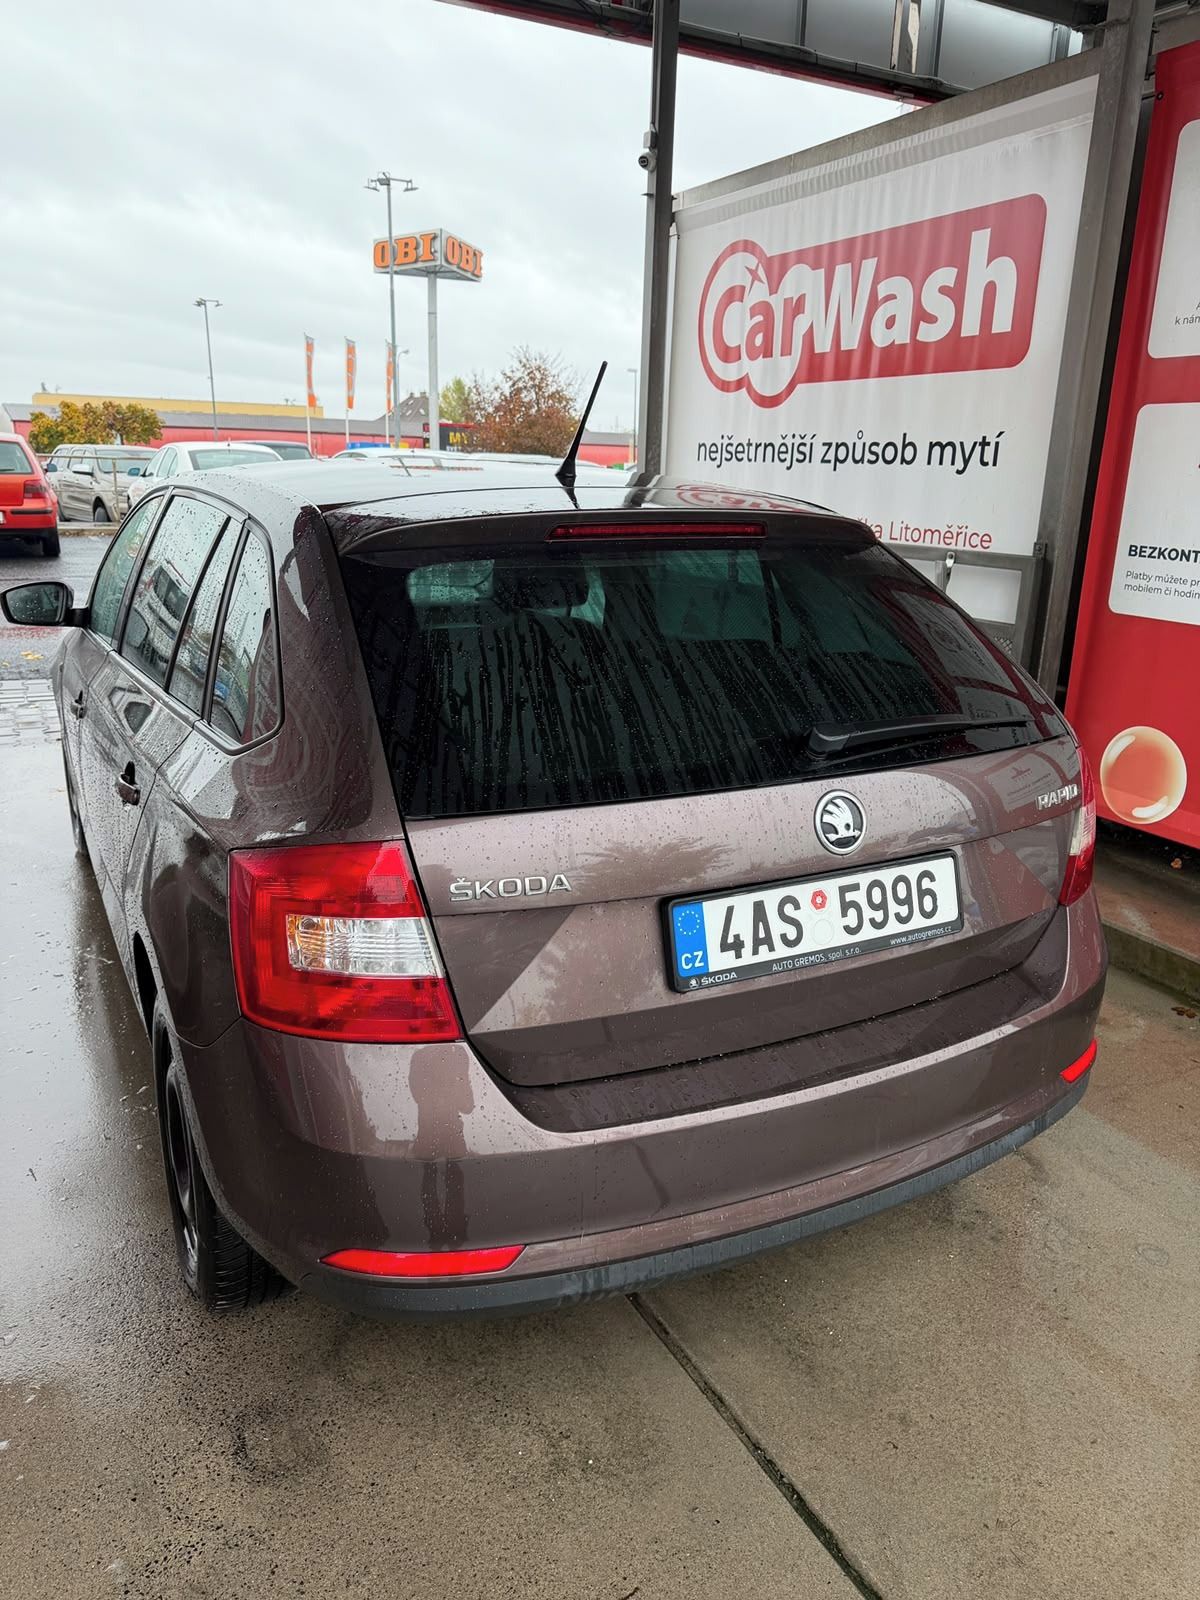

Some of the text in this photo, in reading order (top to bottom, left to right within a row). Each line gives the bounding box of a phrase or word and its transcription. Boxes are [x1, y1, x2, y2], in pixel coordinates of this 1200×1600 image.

[373, 232, 438, 268] OBI
[445, 235, 483, 278] OBI
[711, 227, 1018, 365] CarWash
[696, 430, 1005, 476] nejšetrnější způsob mytí
[889, 521, 992, 549] Litoměřice
[1128, 544, 1200, 563] BEZKONT
[1124, 583, 1162, 595] mobilem
[1164, 587, 1172, 596] či
[1126, 570, 1153, 583] Platby
[1154, 574, 1188, 586] můžete
[1037, 783, 1078, 811] RAPID
[449, 873, 572, 901] ŠKODA
[719, 869, 938, 960] 4AS 5996
[889, 926, 952, 945] www.autogremos.cz
[681, 950, 704, 970] CZ
[772, 960, 793, 972] AUTO
[827, 949, 844, 961] spol.
[845, 947, 862, 957] s.r.o.
[701, 971, 737, 986] ŠKODA
